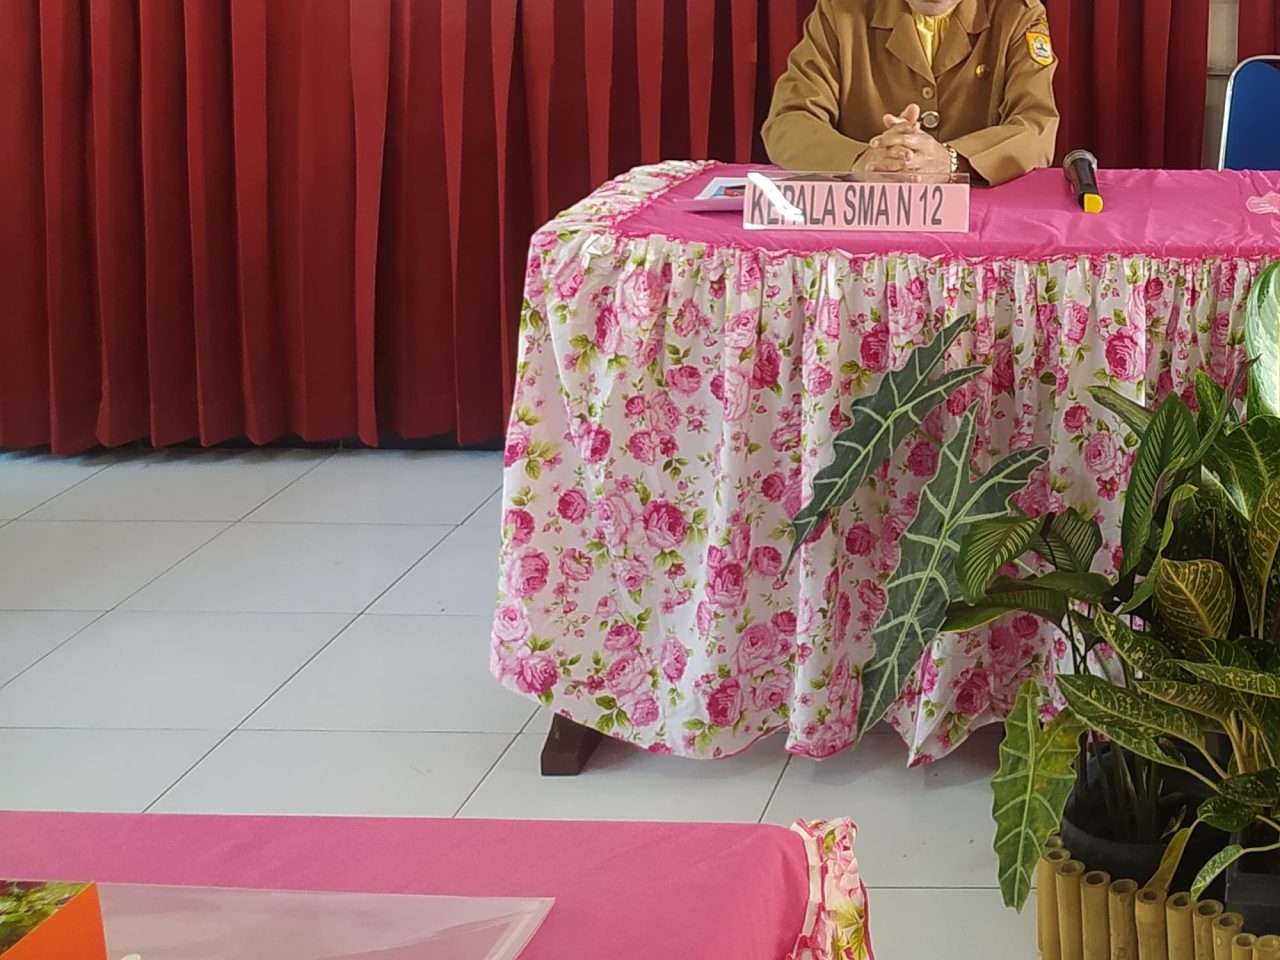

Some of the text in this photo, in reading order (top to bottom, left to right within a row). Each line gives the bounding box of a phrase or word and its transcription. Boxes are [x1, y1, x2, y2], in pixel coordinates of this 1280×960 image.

[843, 185, 890, 227] SMA
[896, 185, 912, 227] N
[918, 186, 944, 227] 12
